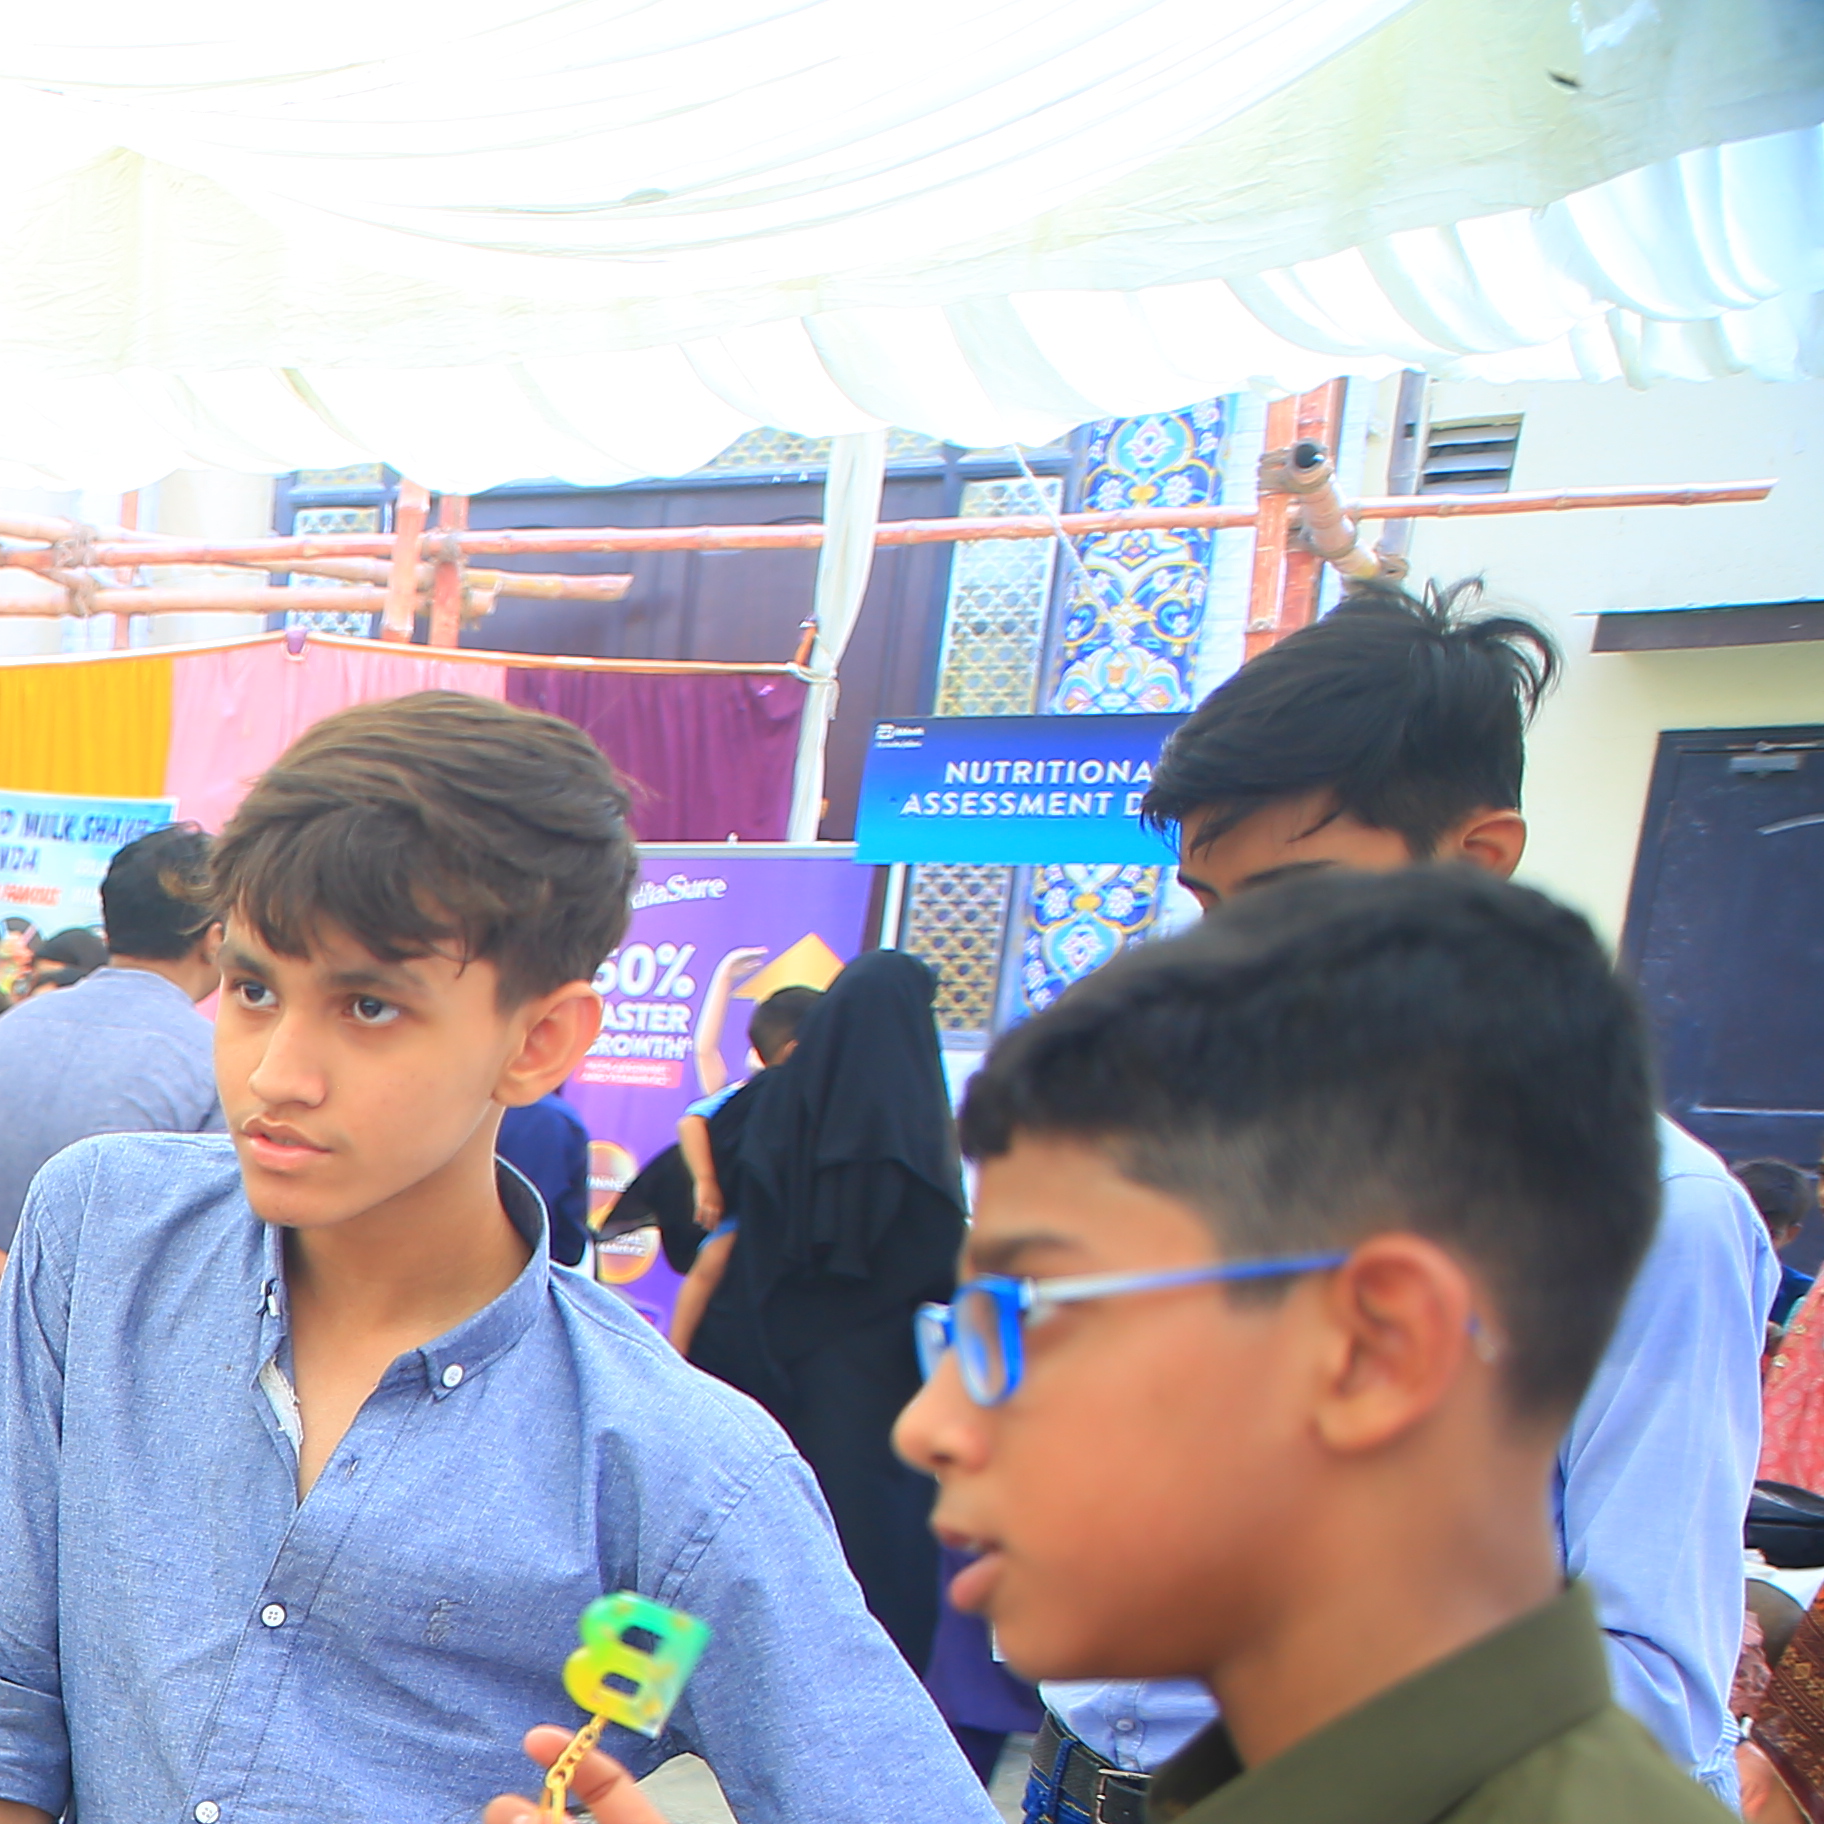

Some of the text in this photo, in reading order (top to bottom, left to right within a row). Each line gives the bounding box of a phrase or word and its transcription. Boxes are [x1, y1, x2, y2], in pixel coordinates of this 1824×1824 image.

[943, 759, 1153, 785] NUTRITIONA
[900, 791, 1114, 817] ASSESSMENT
[20, 812, 75, 842] MILK
[632, 873, 728, 909] diaSure
[601, 1001, 693, 1033] ASTER
